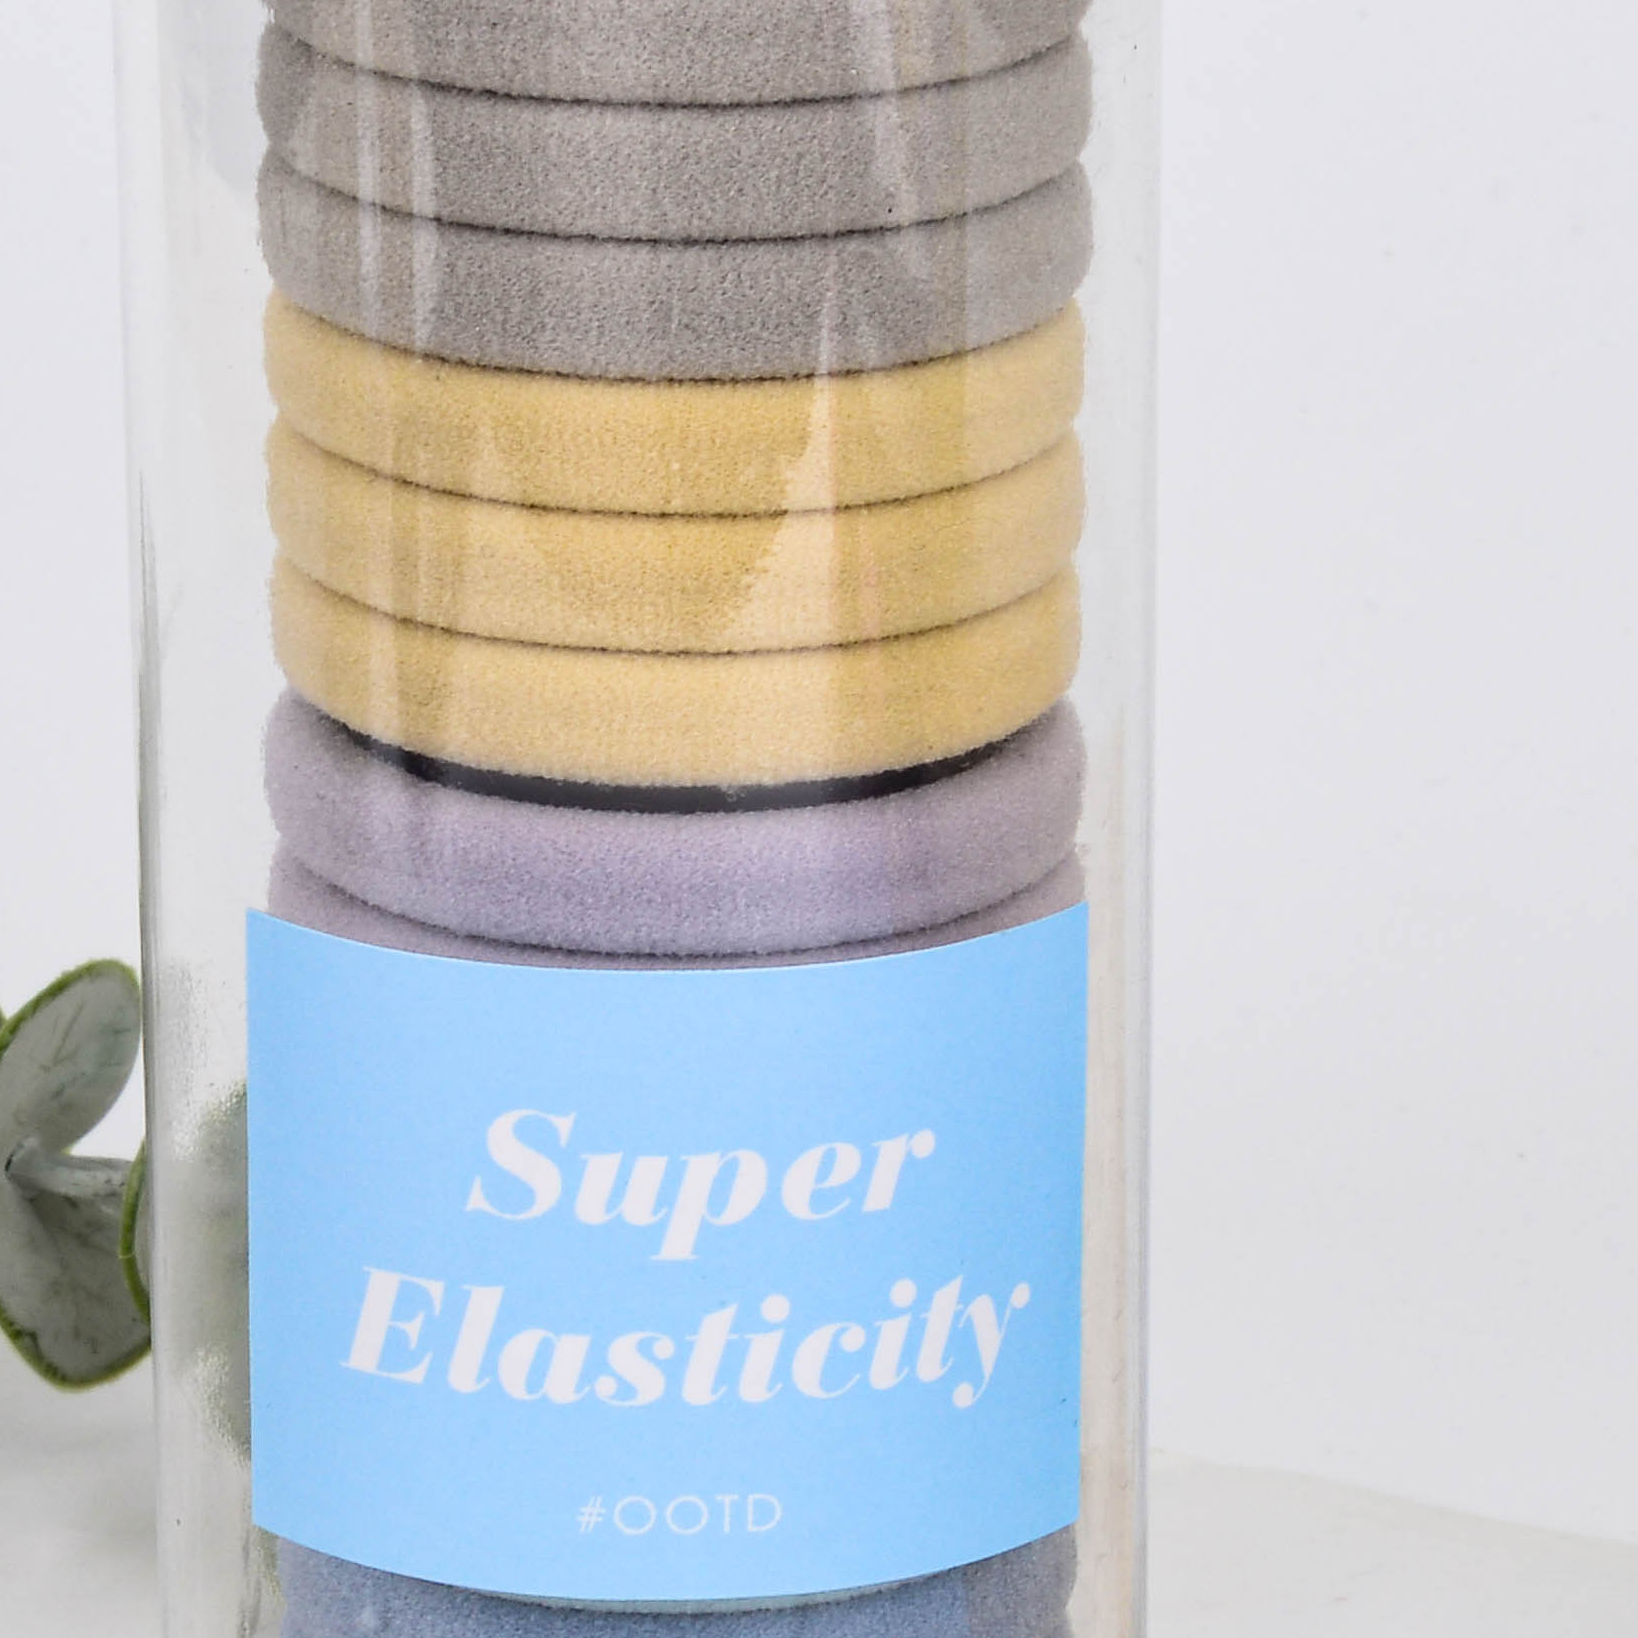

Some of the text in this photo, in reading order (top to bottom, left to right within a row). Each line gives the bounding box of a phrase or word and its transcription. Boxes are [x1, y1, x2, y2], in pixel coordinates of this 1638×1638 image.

[465, 1108, 937, 1262] Super
[339, 1266, 1032, 1410] Elasticity
[575, 1493, 783, 1537] #OOTD
